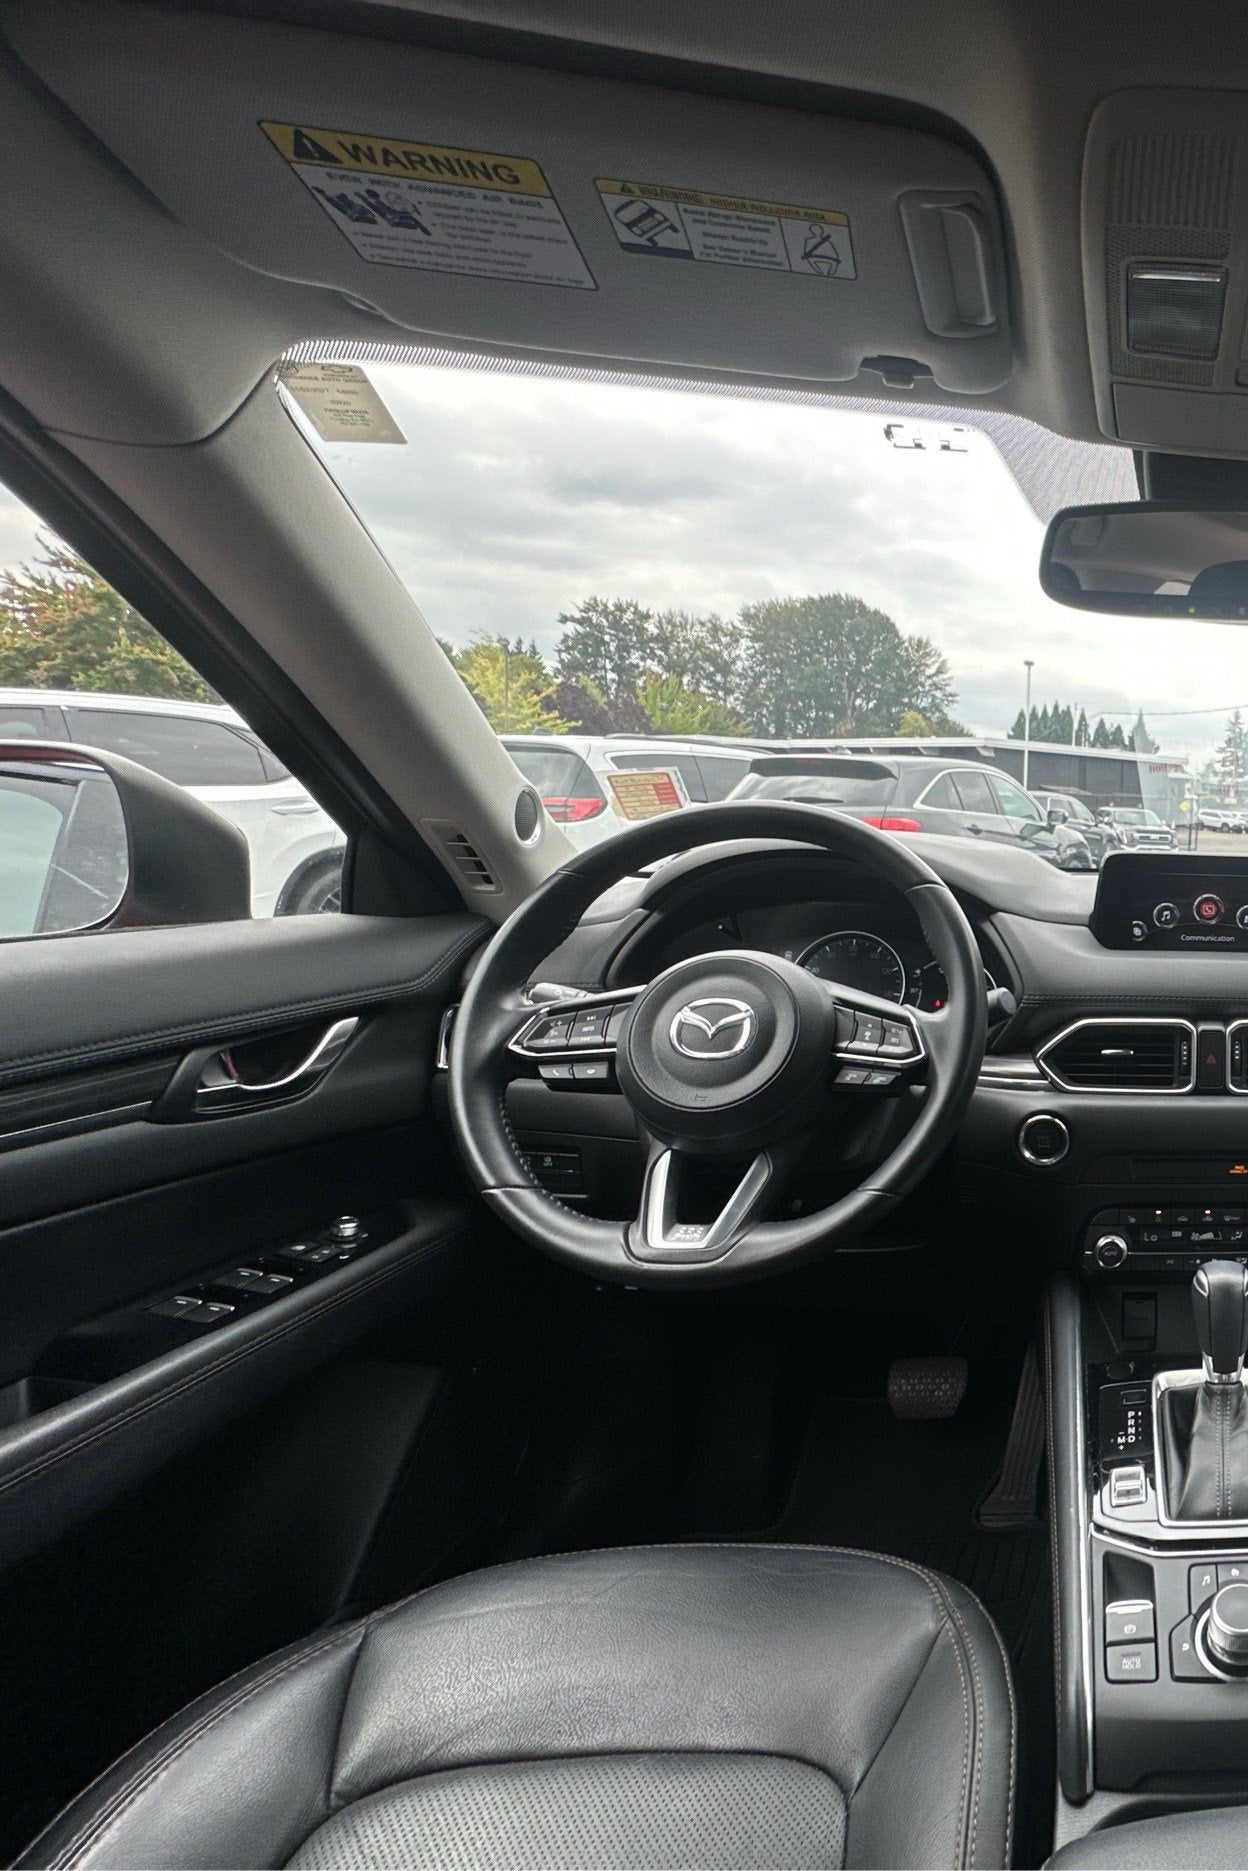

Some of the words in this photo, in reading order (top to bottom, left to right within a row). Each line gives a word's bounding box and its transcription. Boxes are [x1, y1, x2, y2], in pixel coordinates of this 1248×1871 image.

[337, 140, 521, 185] WARNING
[1181, 934, 1235, 943] Communication
[1127, 1410, 1136, 1419] P
[1127, 1418, 1136, 1427] R
[1127, 1426, 1136, 1435] N
[1127, 1435, 1136, 1443] D
